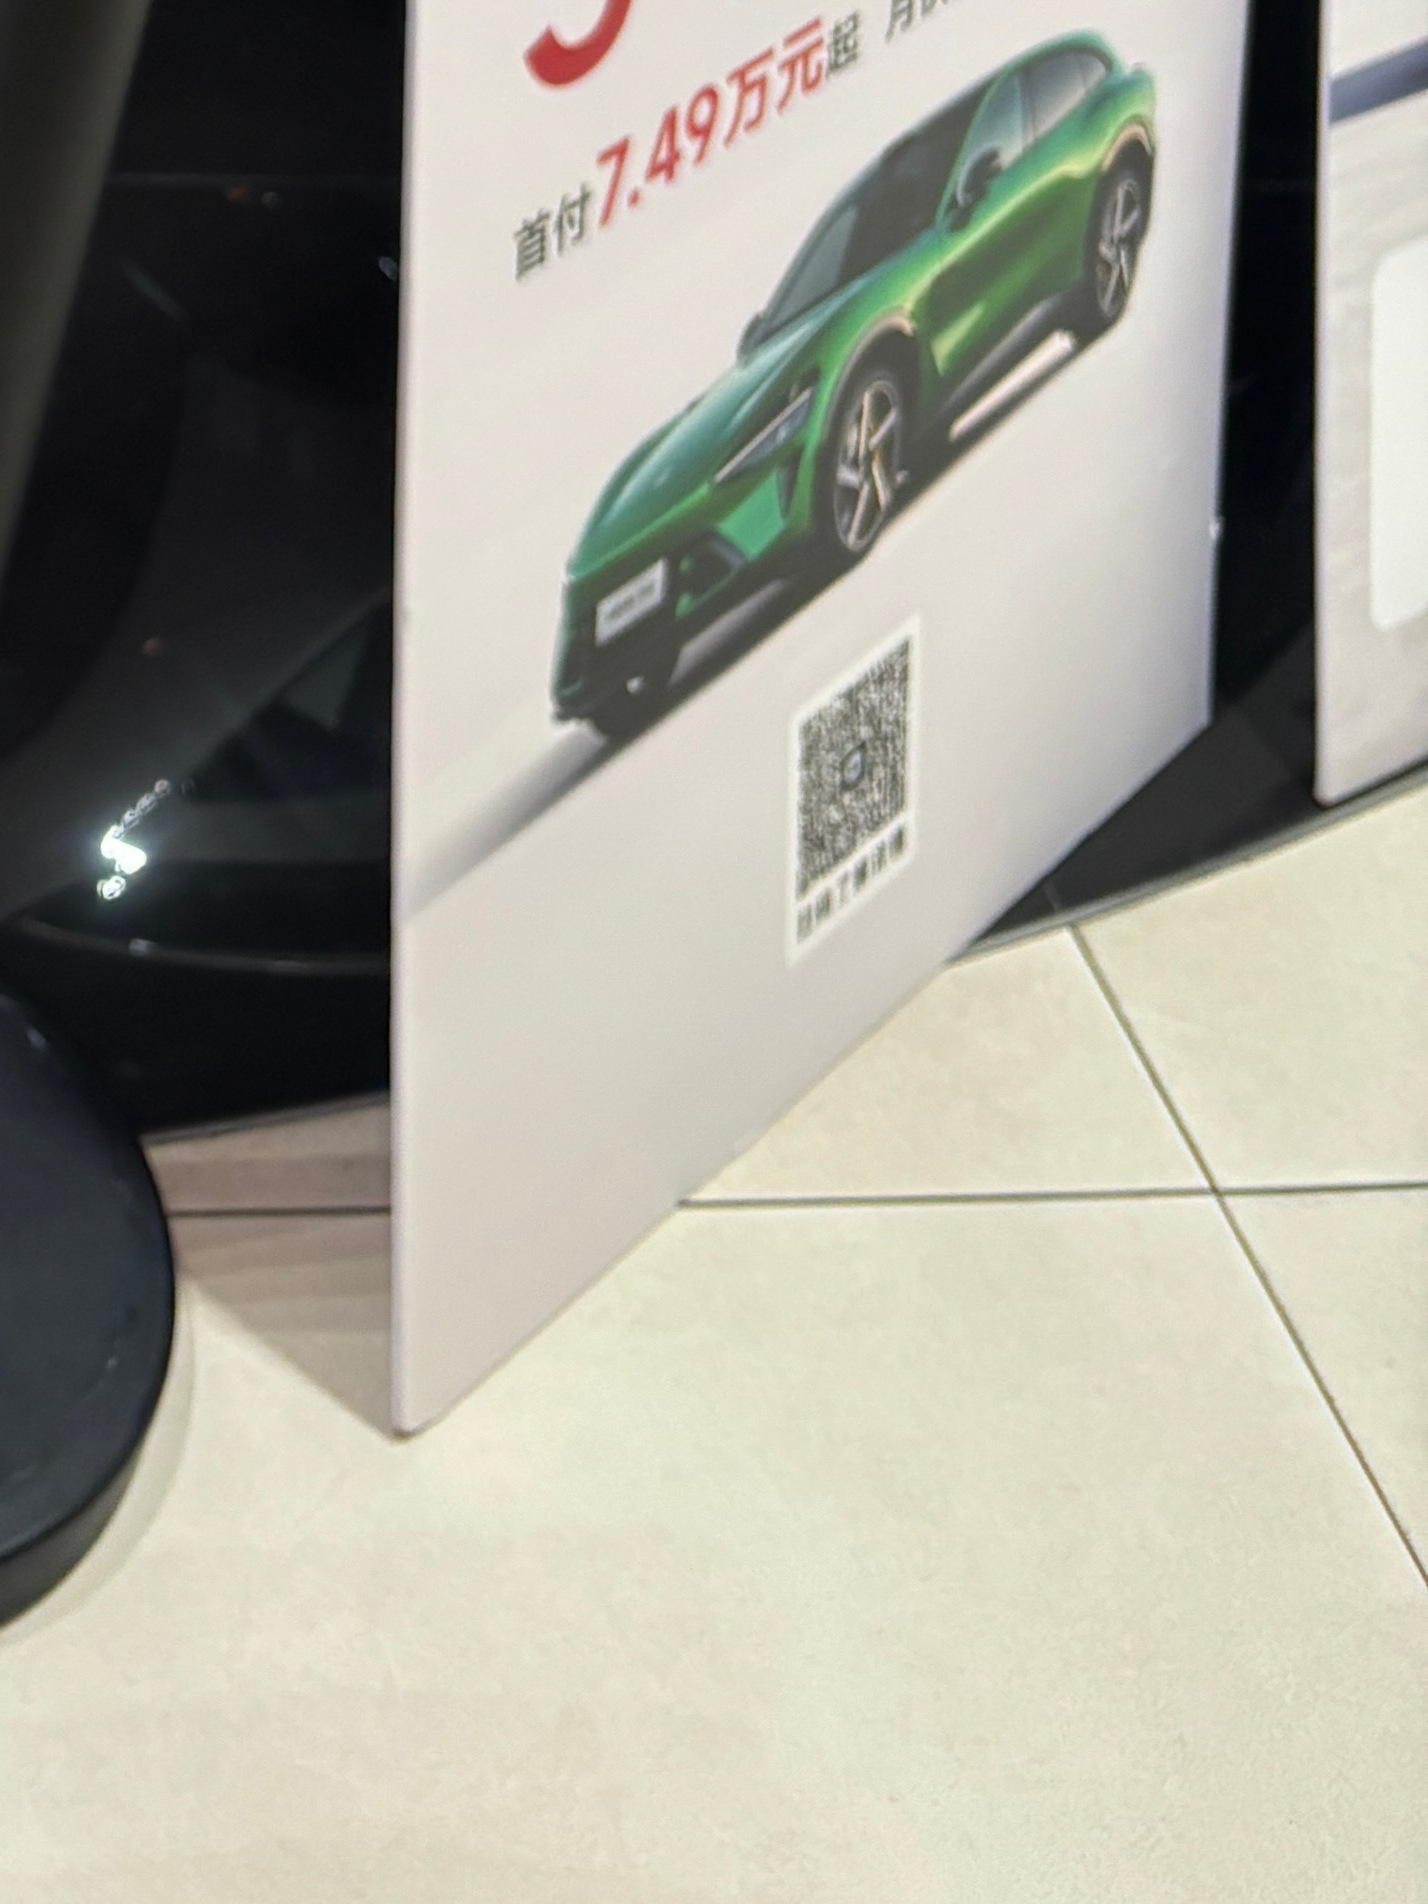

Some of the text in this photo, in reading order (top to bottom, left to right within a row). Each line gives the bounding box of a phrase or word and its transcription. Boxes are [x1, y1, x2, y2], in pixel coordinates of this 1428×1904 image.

[512, 10, 863, 283] 首付7.49万元起
